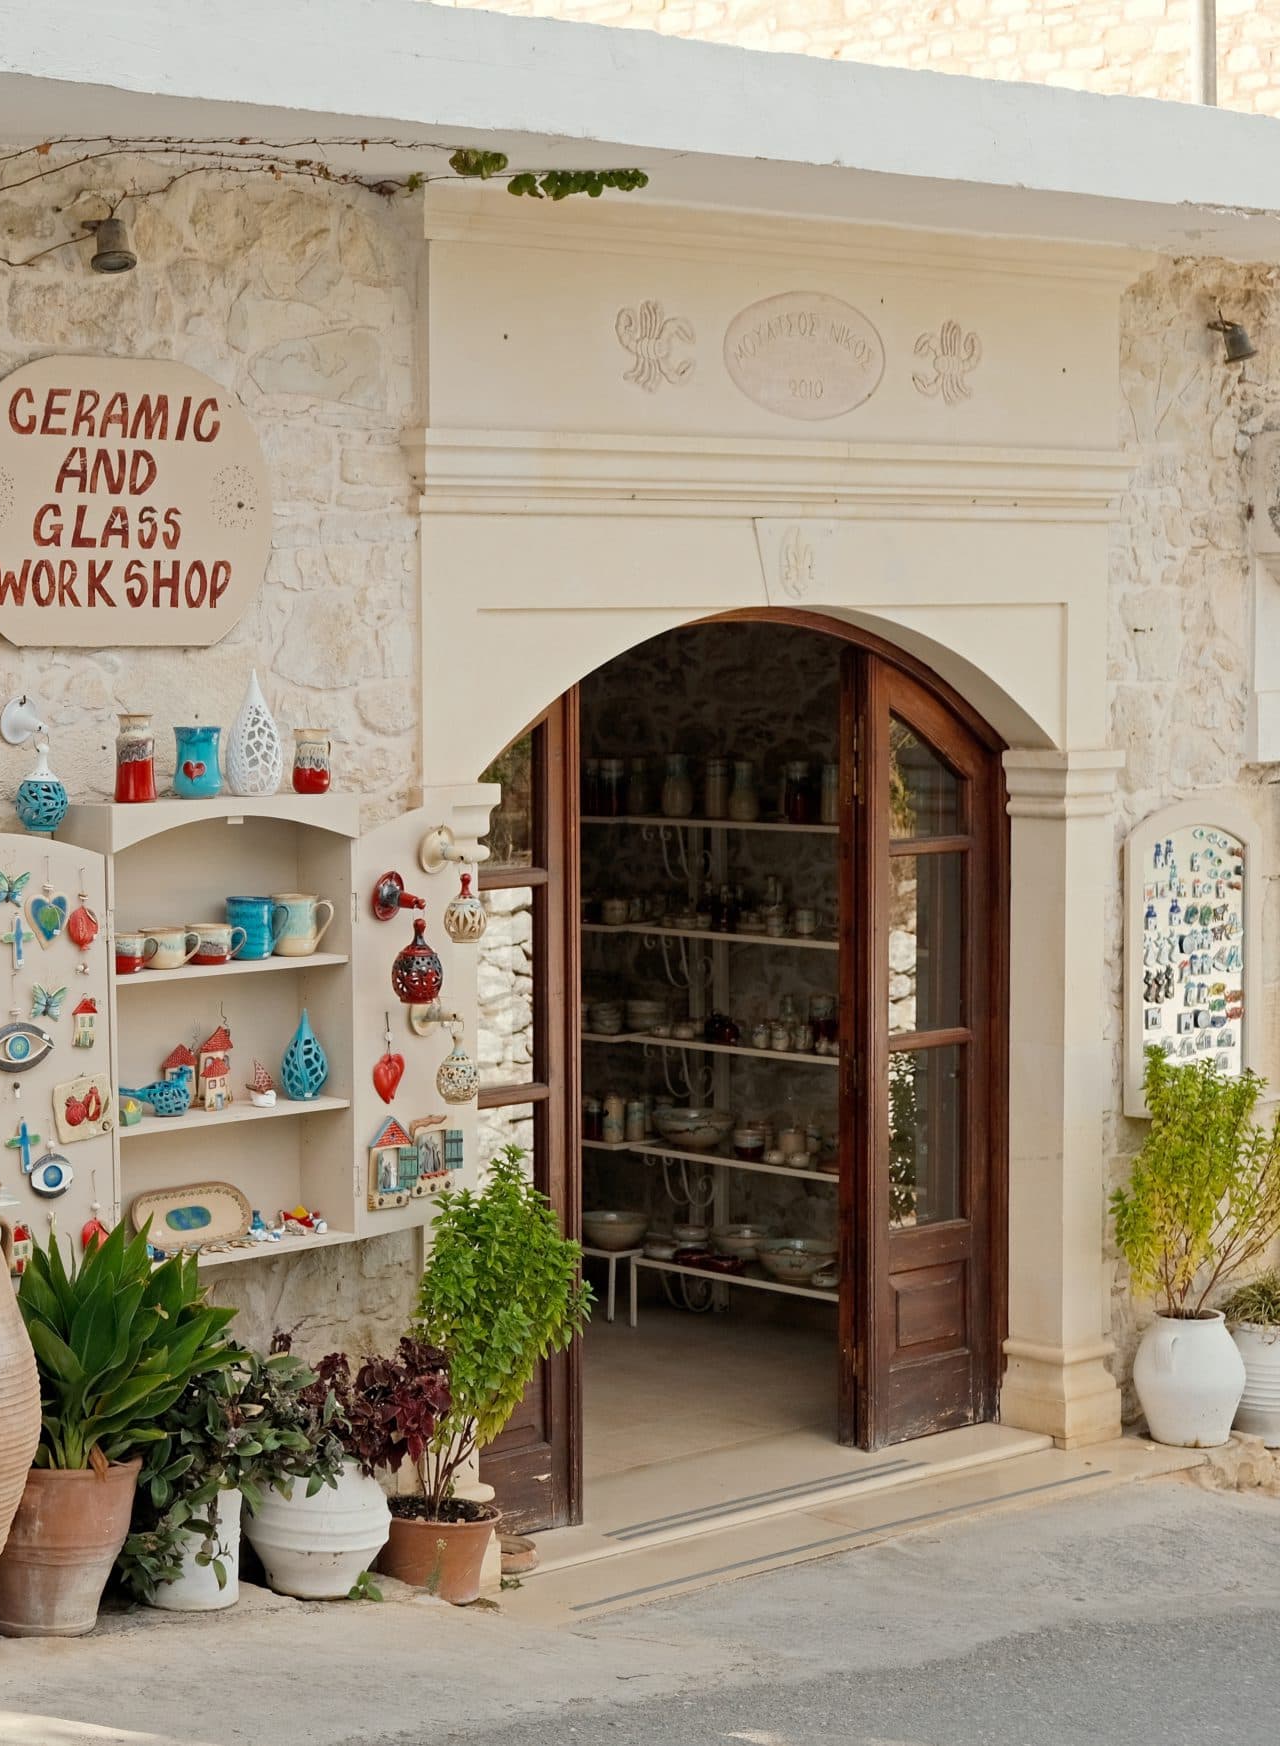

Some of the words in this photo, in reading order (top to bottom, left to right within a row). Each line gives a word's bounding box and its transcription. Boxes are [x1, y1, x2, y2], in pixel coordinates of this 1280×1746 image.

[829, 321, 873, 370] ΝΙΚΟΣ
[788, 378, 824, 400] 2010
[8, 387, 221, 443] CERAMIC
[54, 446, 158, 496] AND
[32, 503, 182, 550] GLASS
